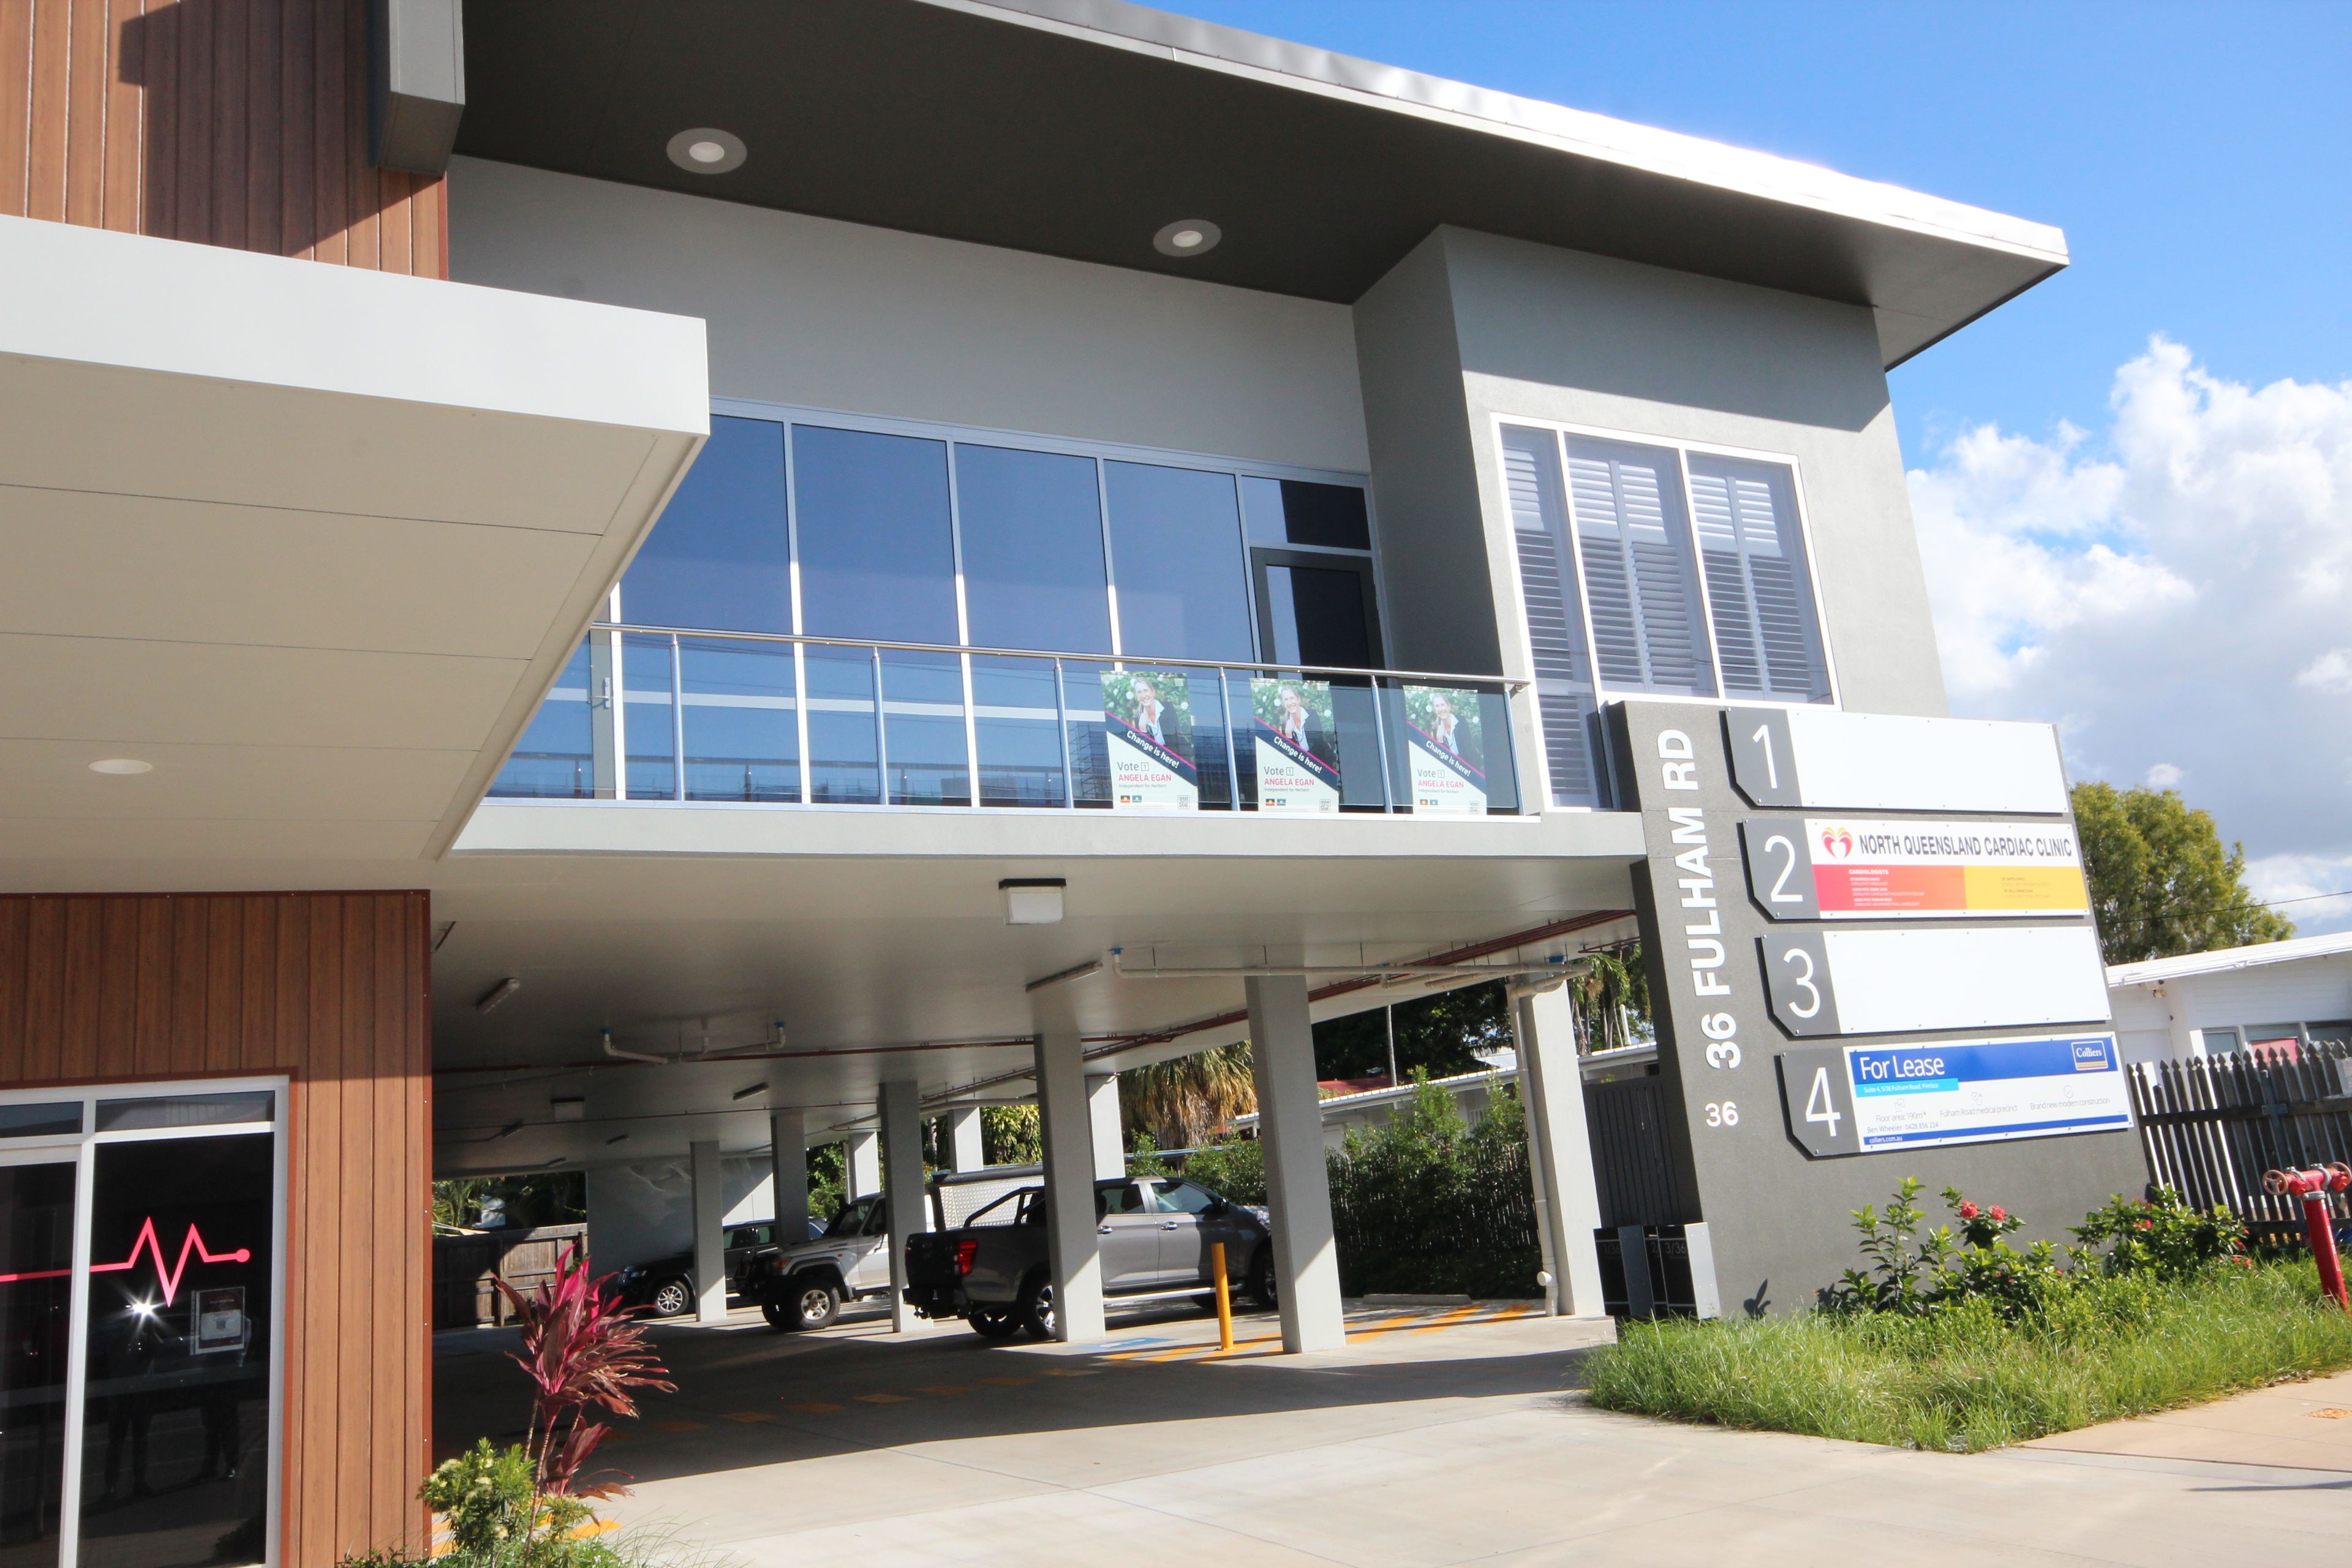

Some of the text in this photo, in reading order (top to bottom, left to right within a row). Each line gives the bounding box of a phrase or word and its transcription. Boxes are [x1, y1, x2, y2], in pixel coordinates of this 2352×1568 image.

[1127, 730, 1180, 769] Change is here!
[1273, 736, 1322, 774] Change is here!
[1426, 740, 1471, 777] Change is here!
[1752, 725, 1777, 790] 1
[1117, 762, 1139, 771] Vote
[1264, 766, 1284, 775] Vote
[1417, 769, 1436, 777] Vote
[1859, 834, 2072, 858] NORTH QUEENSLAND CARDIAC CLINIC
[1765, 835, 1804, 903] 2
[1657, 729, 1742, 1070] 36 FULHAM RD
[1784, 948, 1821, 1019] 3
[2076, 1047, 2103, 1058] Colliers
[1860, 1055, 1945, 1080] For Lease
[1705, 1101, 1740, 1127] 36
[1805, 1067, 1841, 1137] 4
[1976, 1105, 1996, 1114] medical
[1997, 1105, 2018, 1115] precinct
[2079, 1098, 2111, 1106] construction
[1665, 1242, 1686, 1254] 3/36
